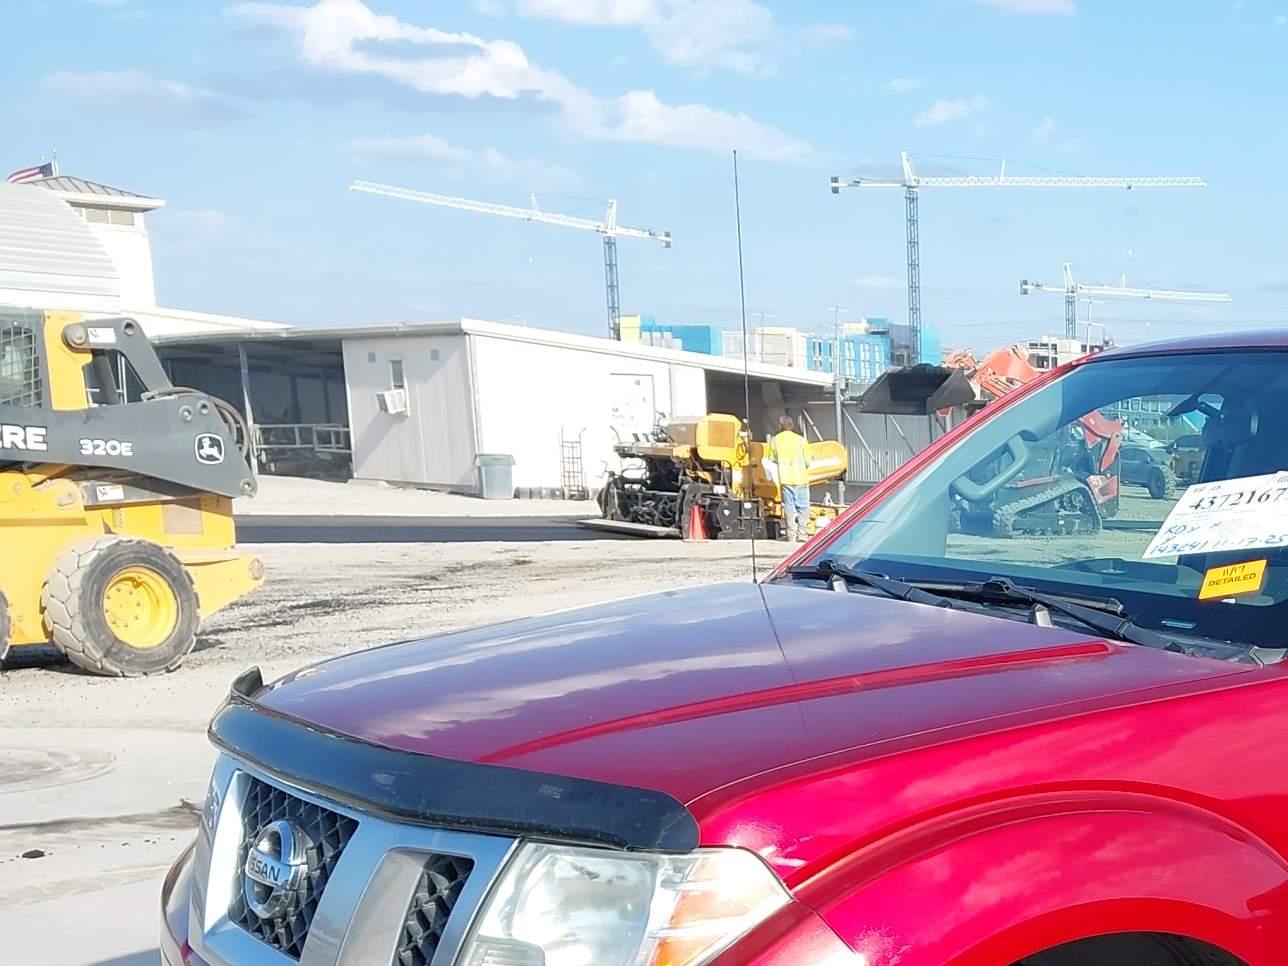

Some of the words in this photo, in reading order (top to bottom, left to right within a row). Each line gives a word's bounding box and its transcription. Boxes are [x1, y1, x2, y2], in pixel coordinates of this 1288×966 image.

[0, 424, 48, 451] RE
[79, 439, 133, 456] 320E
[1208, 572, 1257, 587] DETAILED
